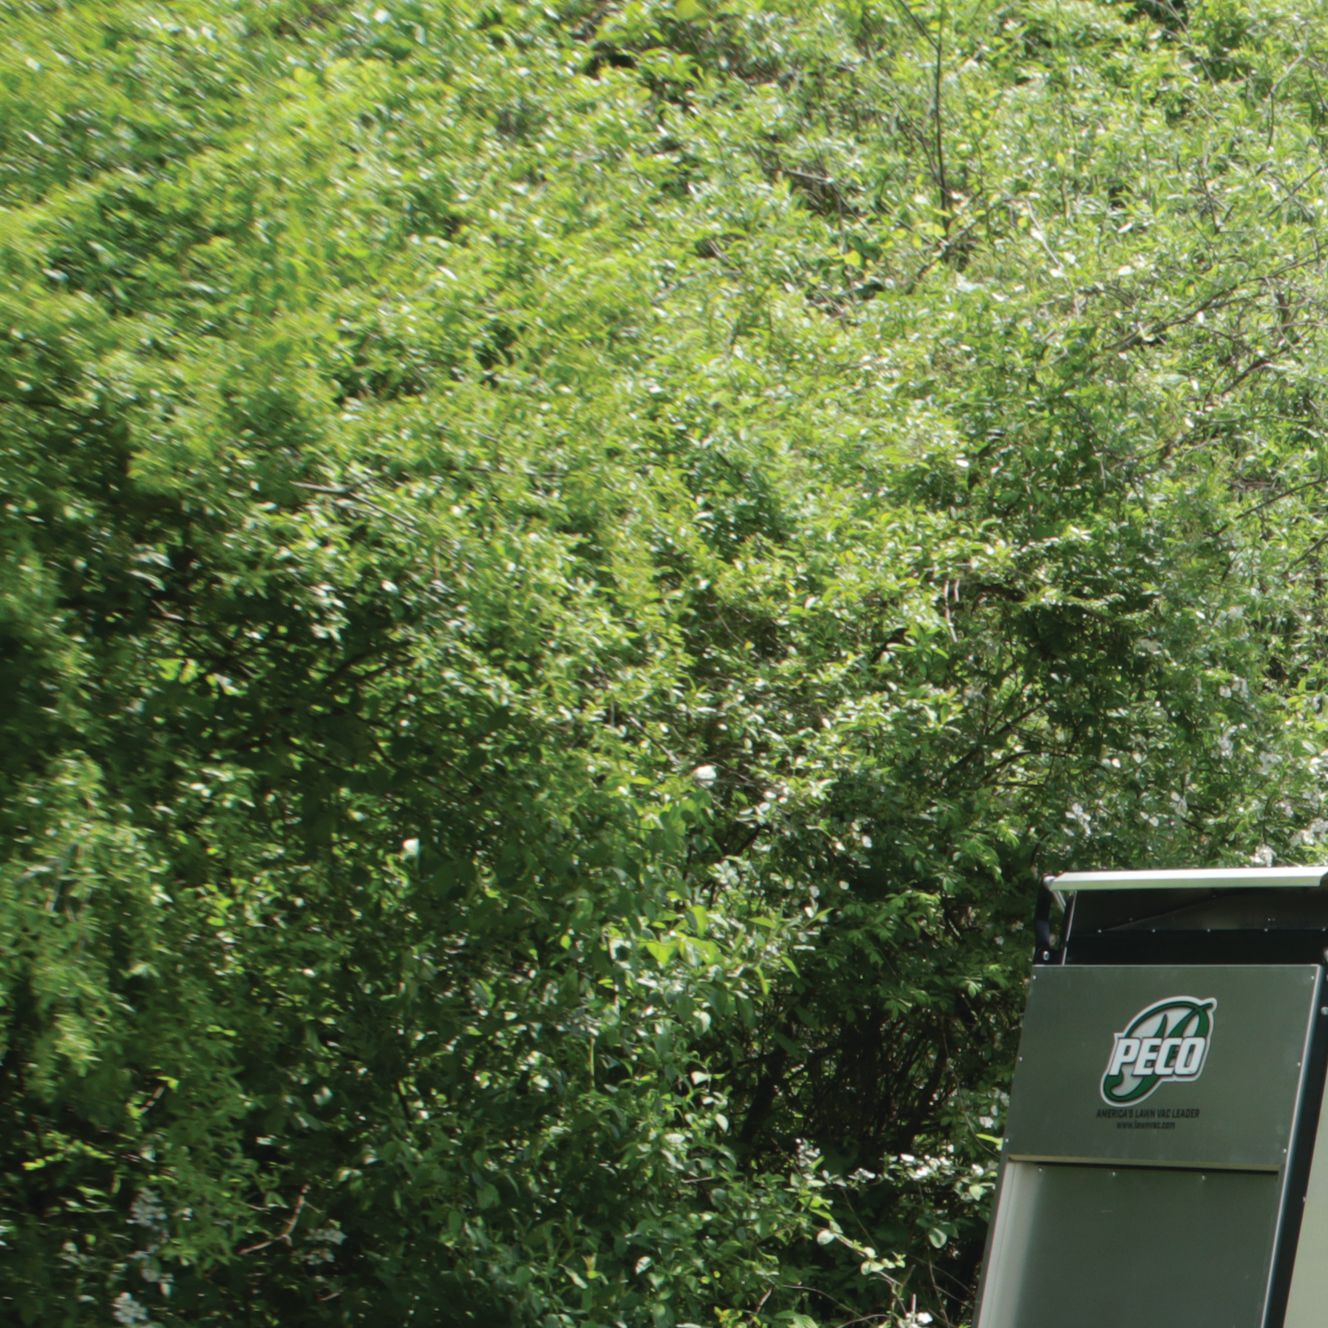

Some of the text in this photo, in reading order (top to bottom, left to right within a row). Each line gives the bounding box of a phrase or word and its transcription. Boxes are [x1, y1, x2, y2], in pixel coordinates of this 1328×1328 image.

[1108, 1037, 1206, 1076] PECO
[1096, 1108, 1200, 1119] AMERICA'S LAWN VAC LEADER
